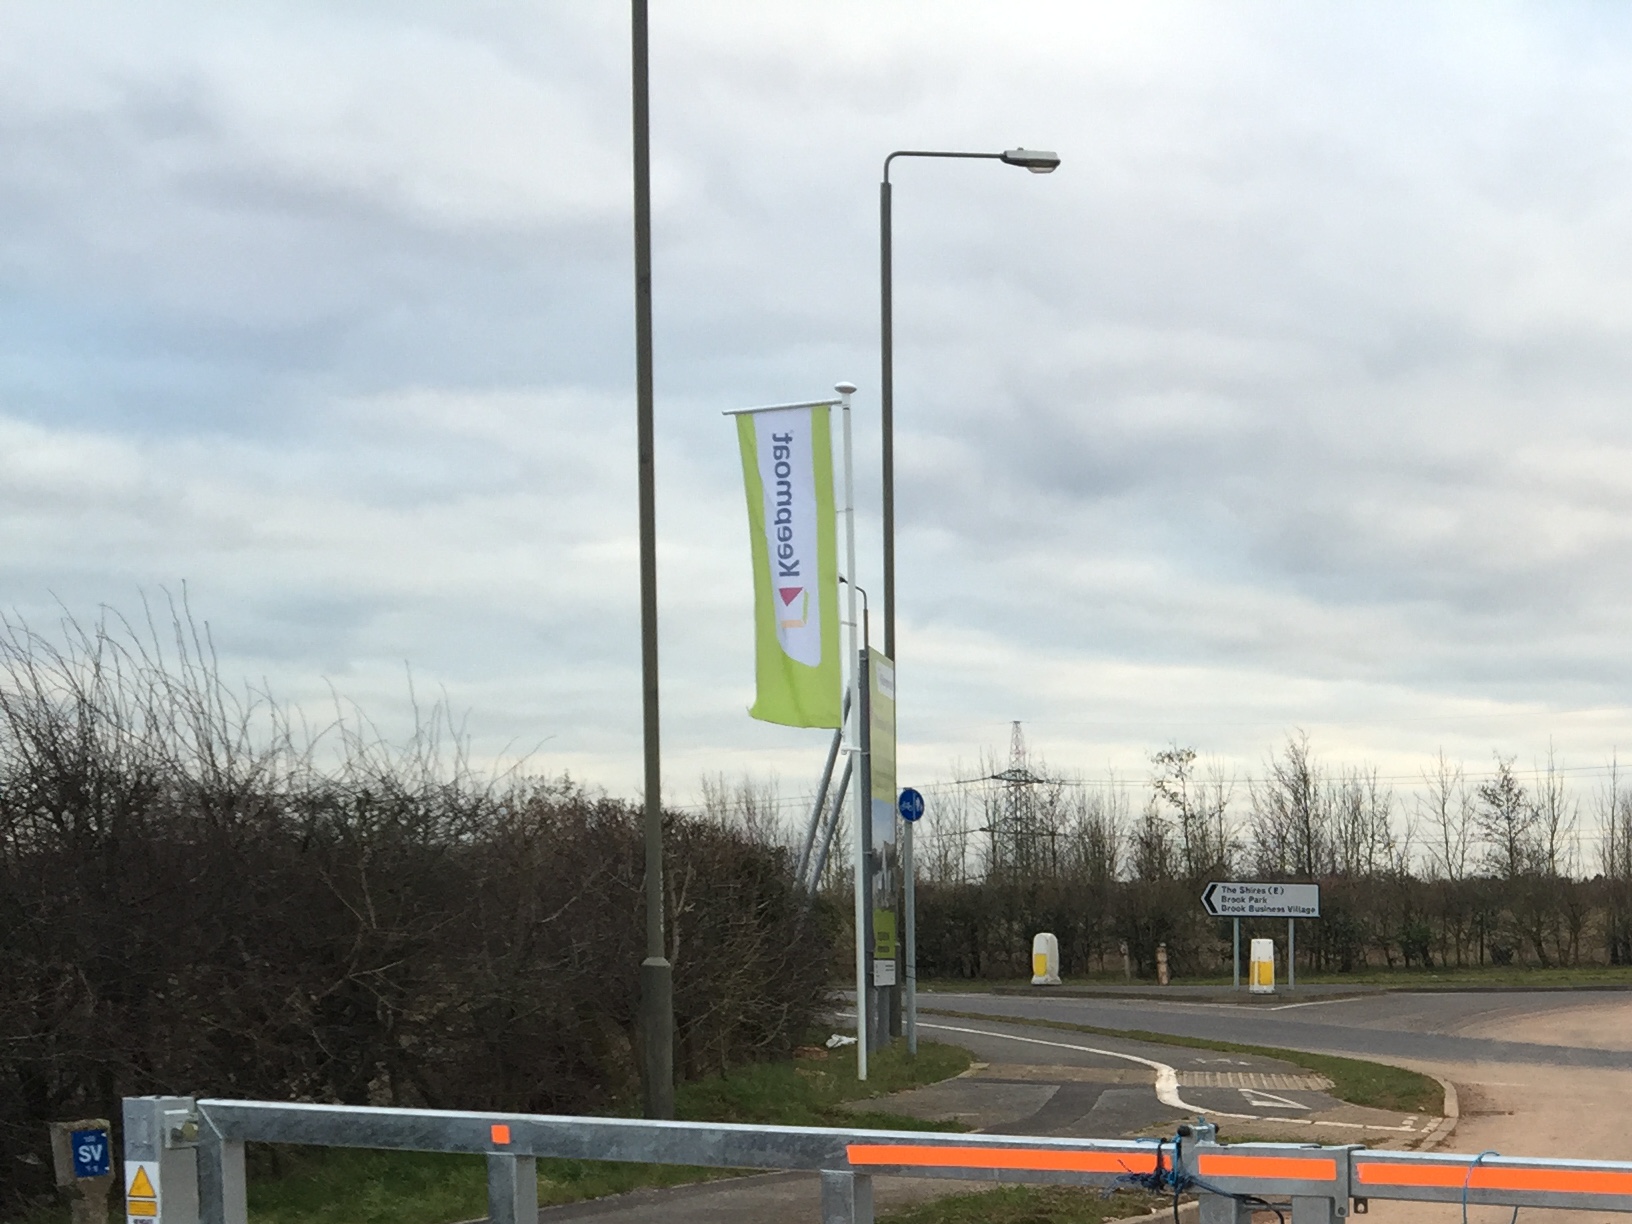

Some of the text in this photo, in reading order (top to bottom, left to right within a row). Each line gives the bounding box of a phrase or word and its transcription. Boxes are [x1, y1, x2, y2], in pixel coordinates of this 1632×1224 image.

[1221, 886, 1285, 896] The Shires (E)
[1221, 895, 1268, 904] Brook Park
[1221, 904, 1316, 915] Brook Business Village
[78, 1144, 103, 1163] SV
